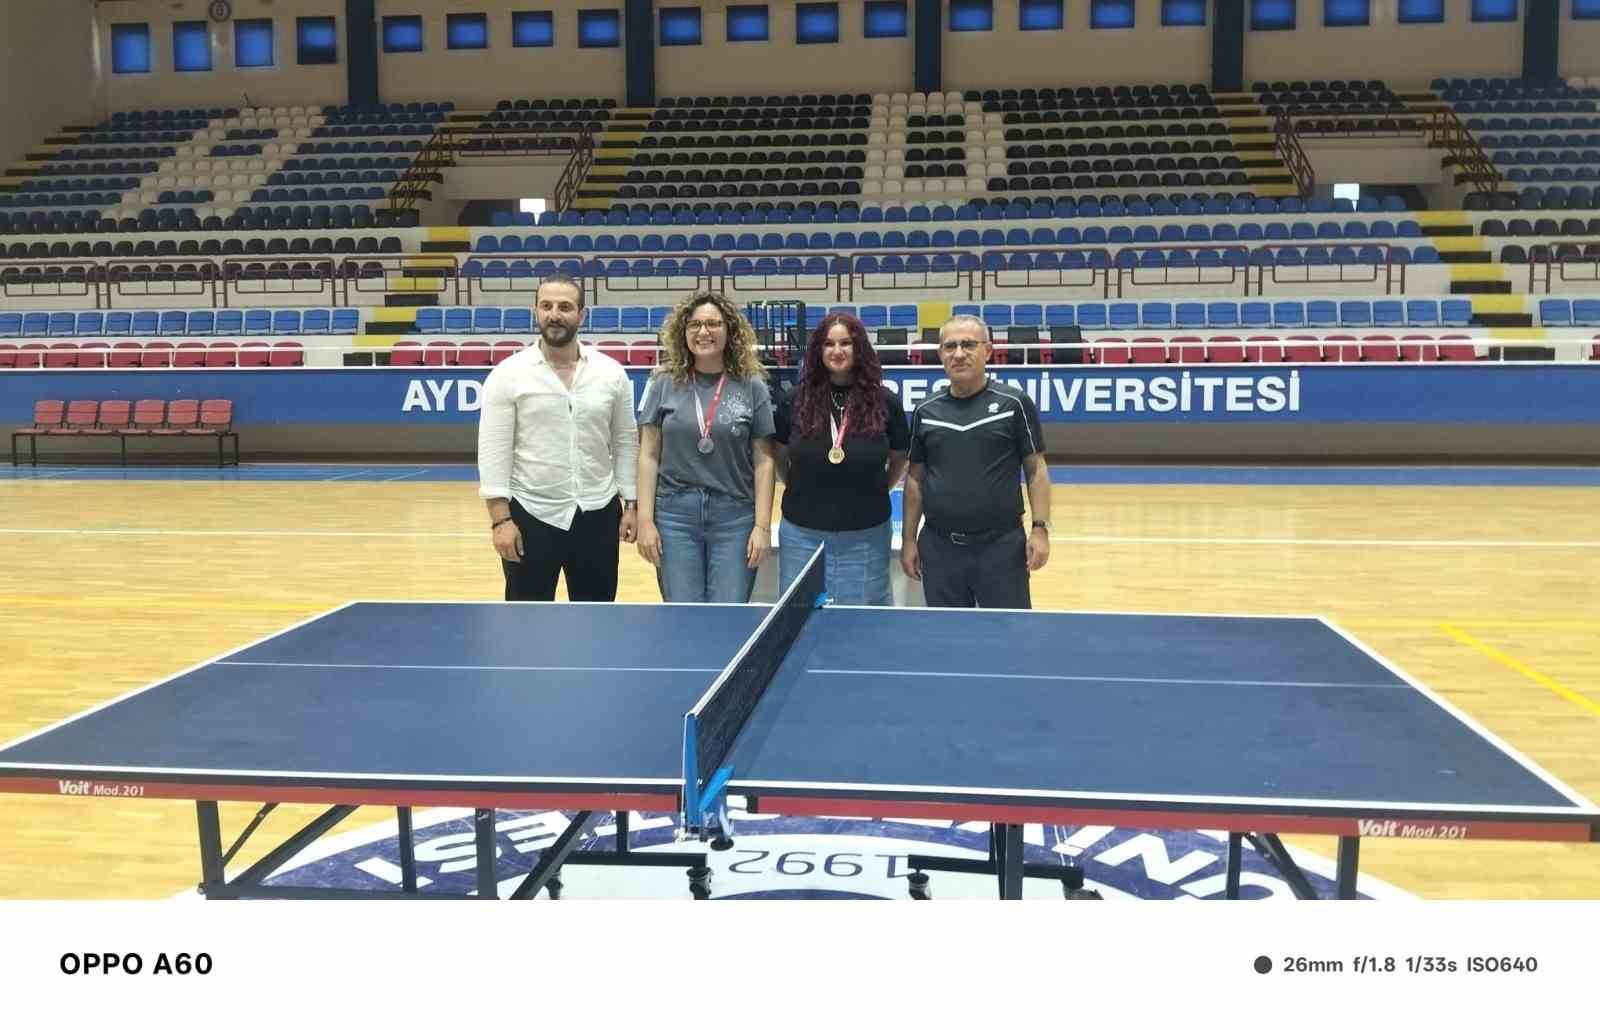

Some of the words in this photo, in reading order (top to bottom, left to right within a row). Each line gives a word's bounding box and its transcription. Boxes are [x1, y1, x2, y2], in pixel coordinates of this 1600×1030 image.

[402, 379, 482, 412] AYD
[984, 369, 1300, 412] NİVERSİTESİ
[58, 780, 90, 795] Voit
[94, 784, 145, 797] Mod.201
[1358, 819, 1397, 837] Voit
[1401, 824, 1467, 839] Mod.201
